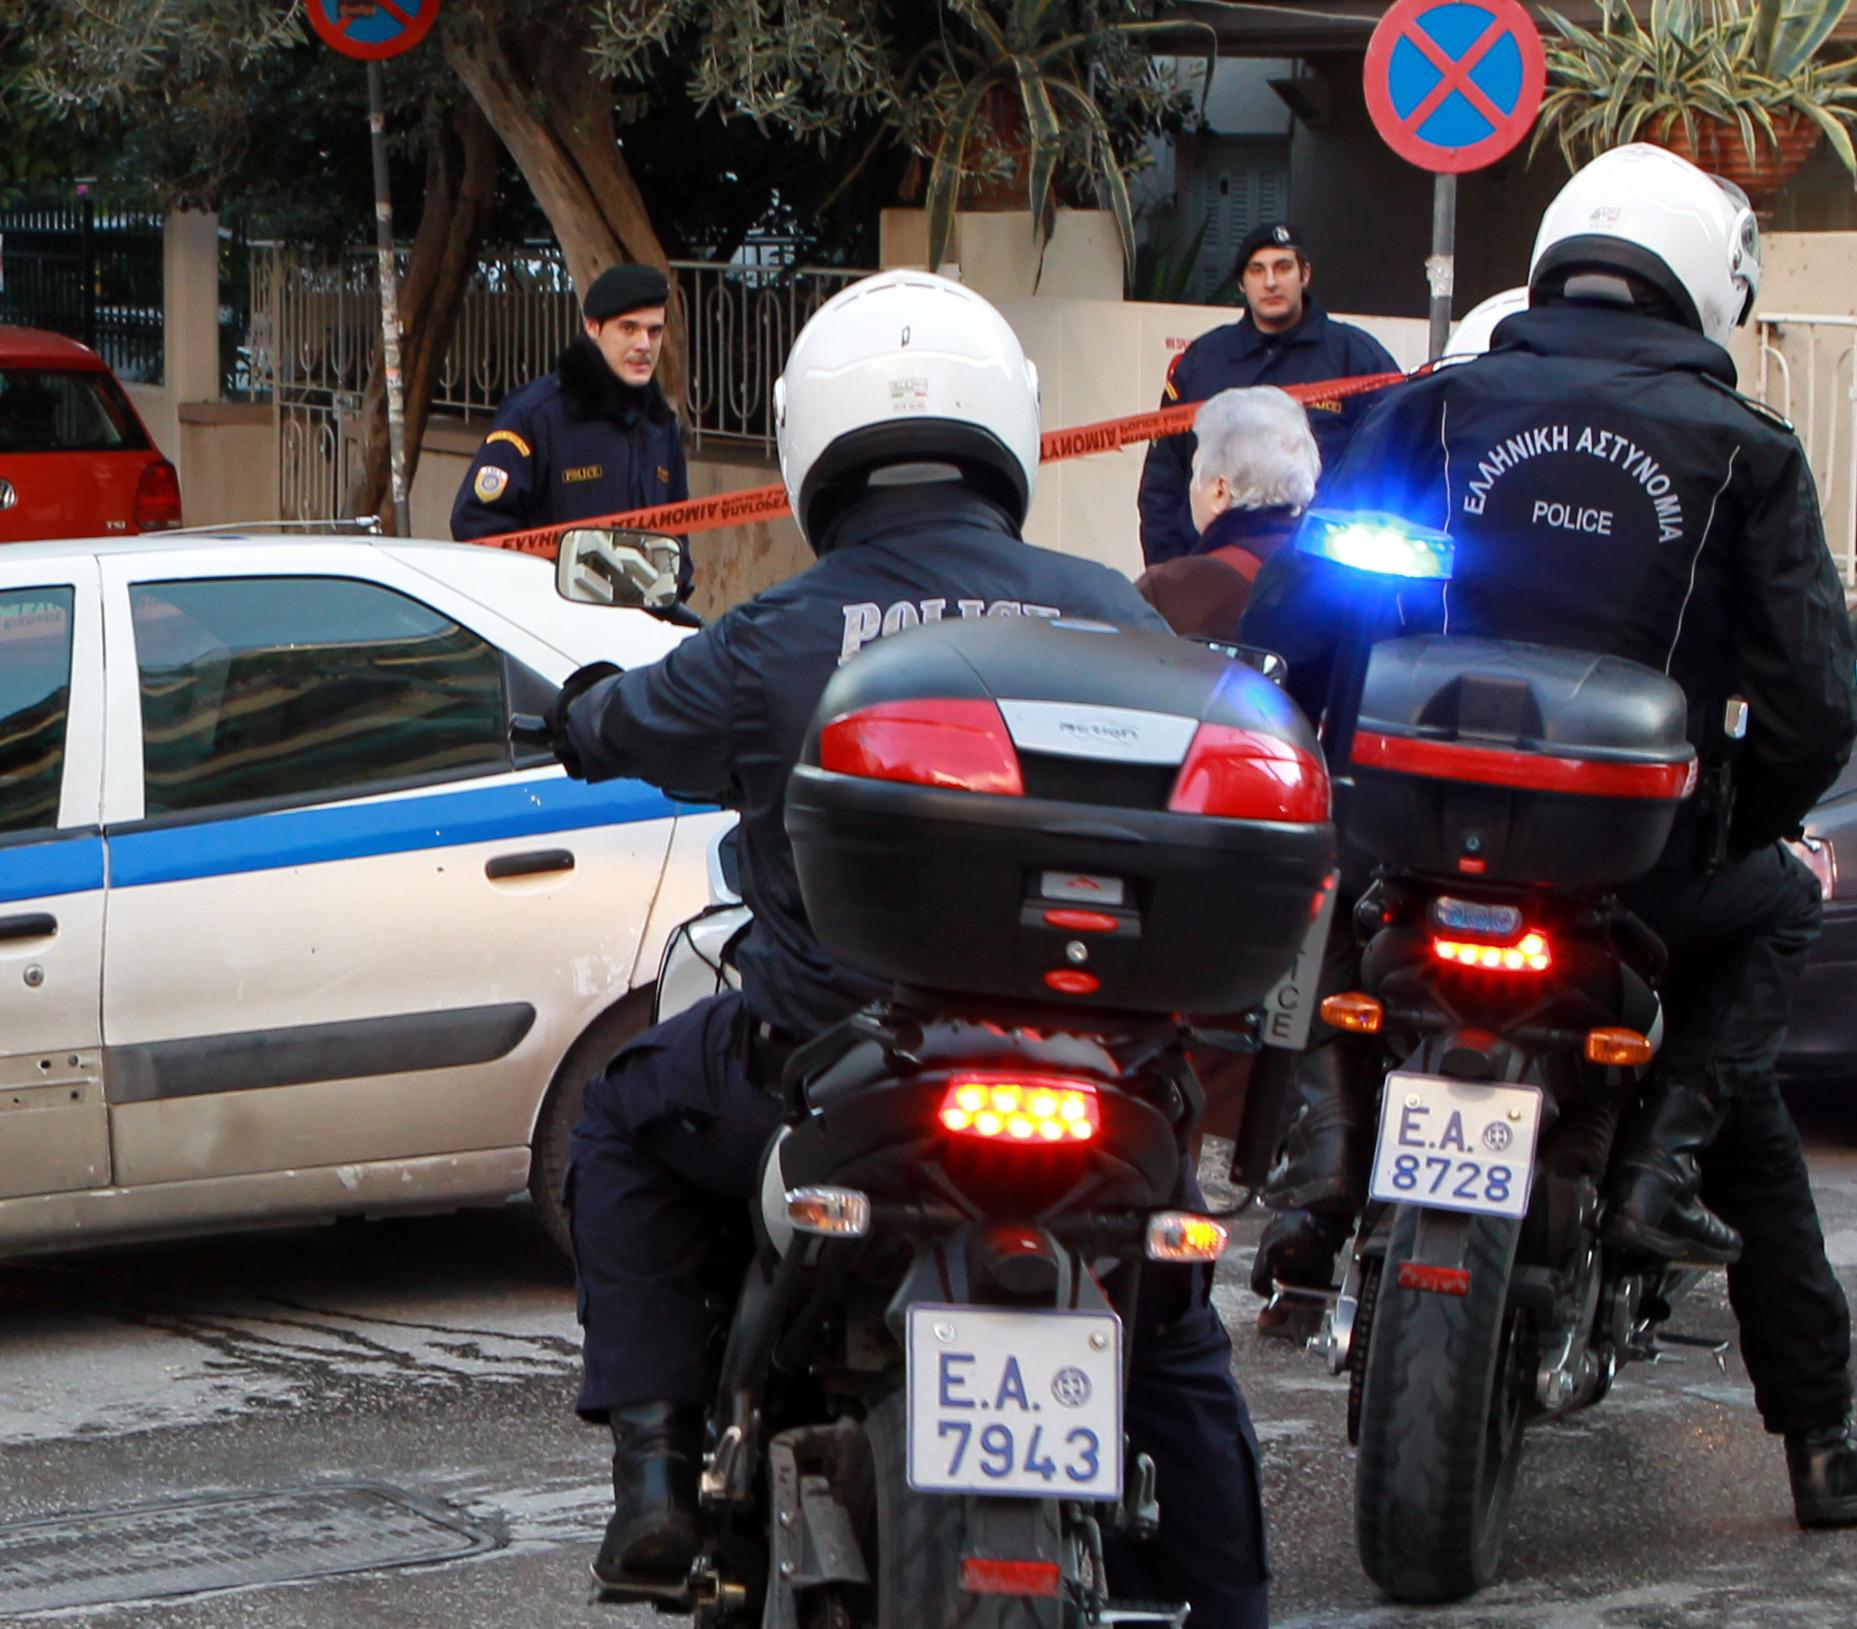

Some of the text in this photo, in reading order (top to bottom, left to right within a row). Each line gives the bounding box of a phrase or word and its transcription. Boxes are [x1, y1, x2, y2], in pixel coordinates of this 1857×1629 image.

[565, 466, 600, 481] POLICE
[1463, 425, 1684, 543] ΕΛΛΗΝΙΚΗ ΑΣΤΥΝΟΜΙΑ
[1532, 500, 1613, 535] POLICE
[1392, 1154, 1512, 1202] 8728
[938, 1420, 1100, 1483] 7943
